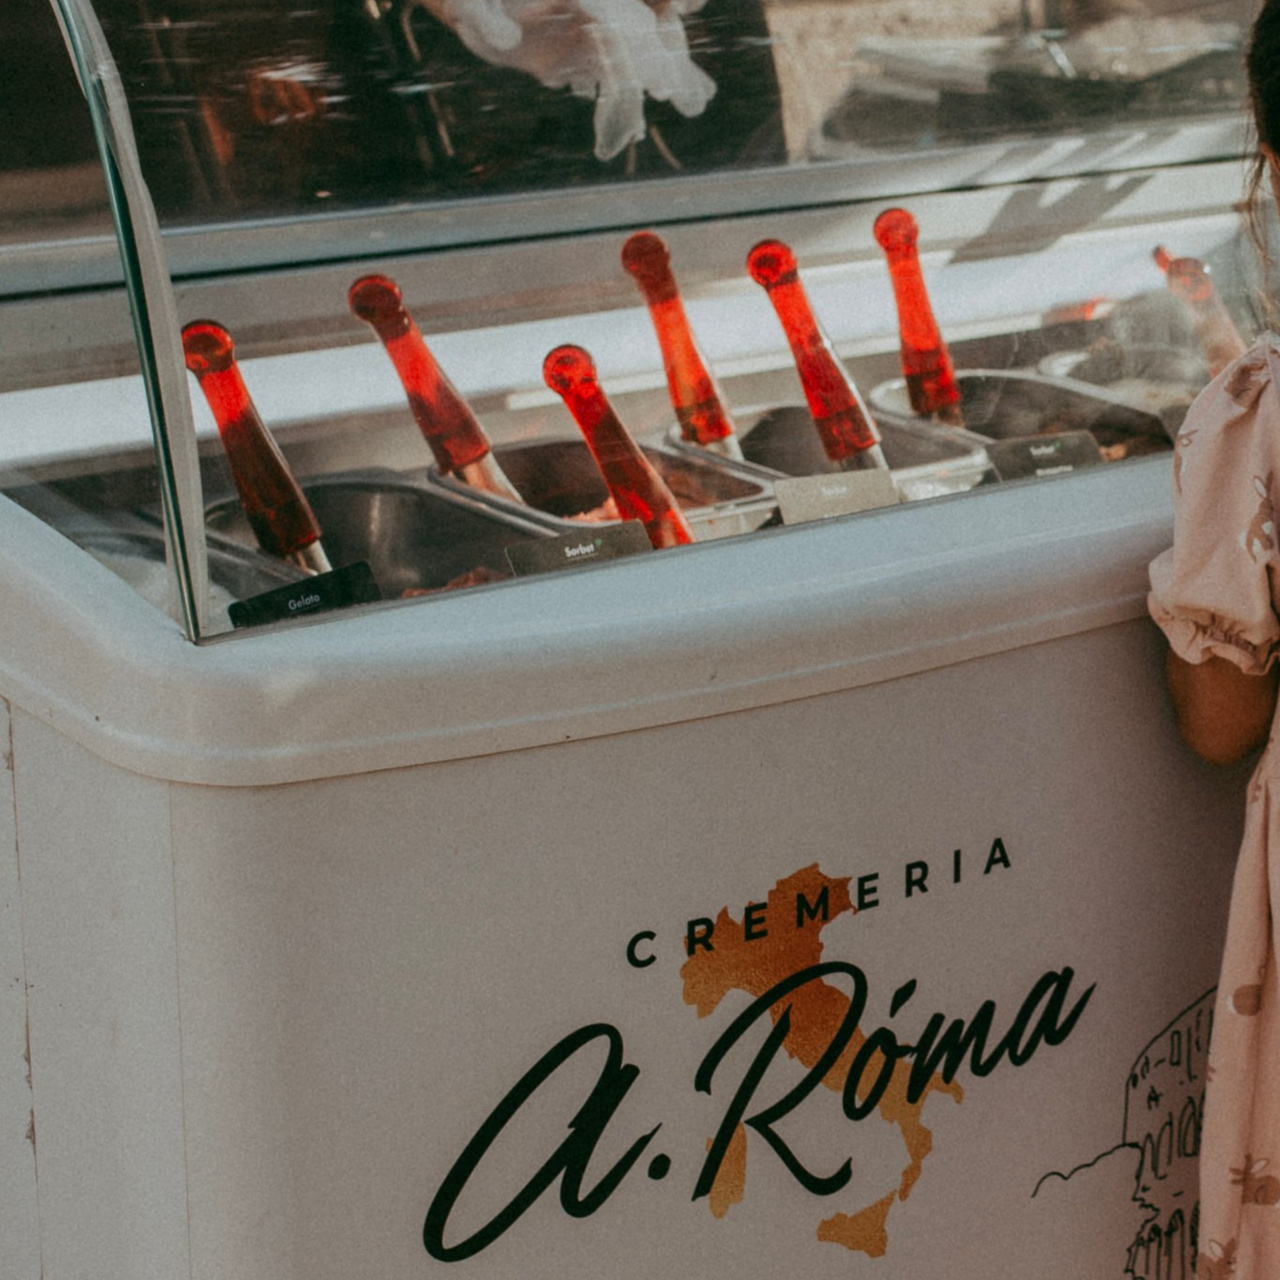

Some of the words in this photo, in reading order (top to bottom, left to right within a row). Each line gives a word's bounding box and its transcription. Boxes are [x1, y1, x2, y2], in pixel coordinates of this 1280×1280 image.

[564, 542, 595, 558] Sorbet
[288, 593, 320, 611] Gelato
[625, 837, 1012, 969] CREMERIA
